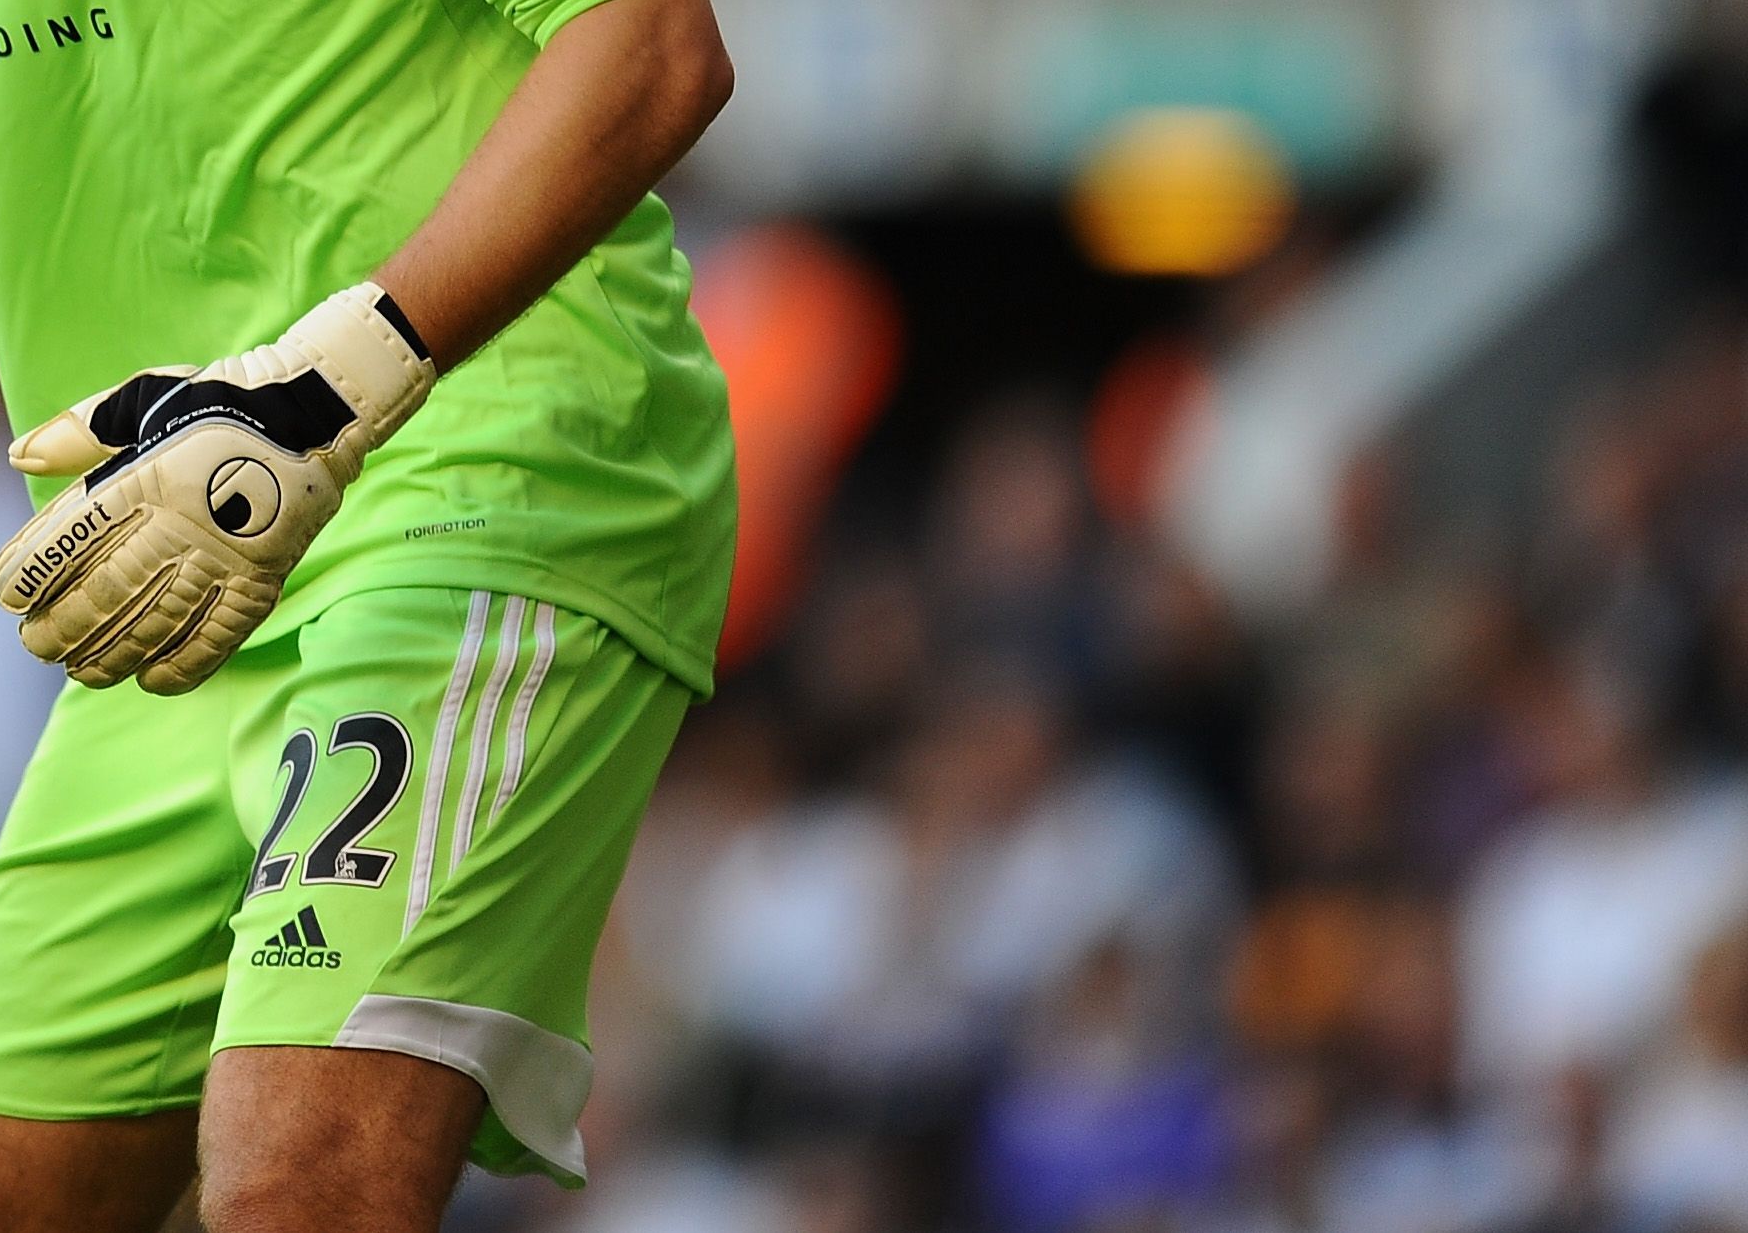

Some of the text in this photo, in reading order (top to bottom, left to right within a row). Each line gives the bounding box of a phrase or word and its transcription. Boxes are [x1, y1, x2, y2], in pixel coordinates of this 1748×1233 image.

[14, 500, 112, 599] uhlsport
[244, 710, 414, 902] 22
[250, 945, 342, 969] adidas
